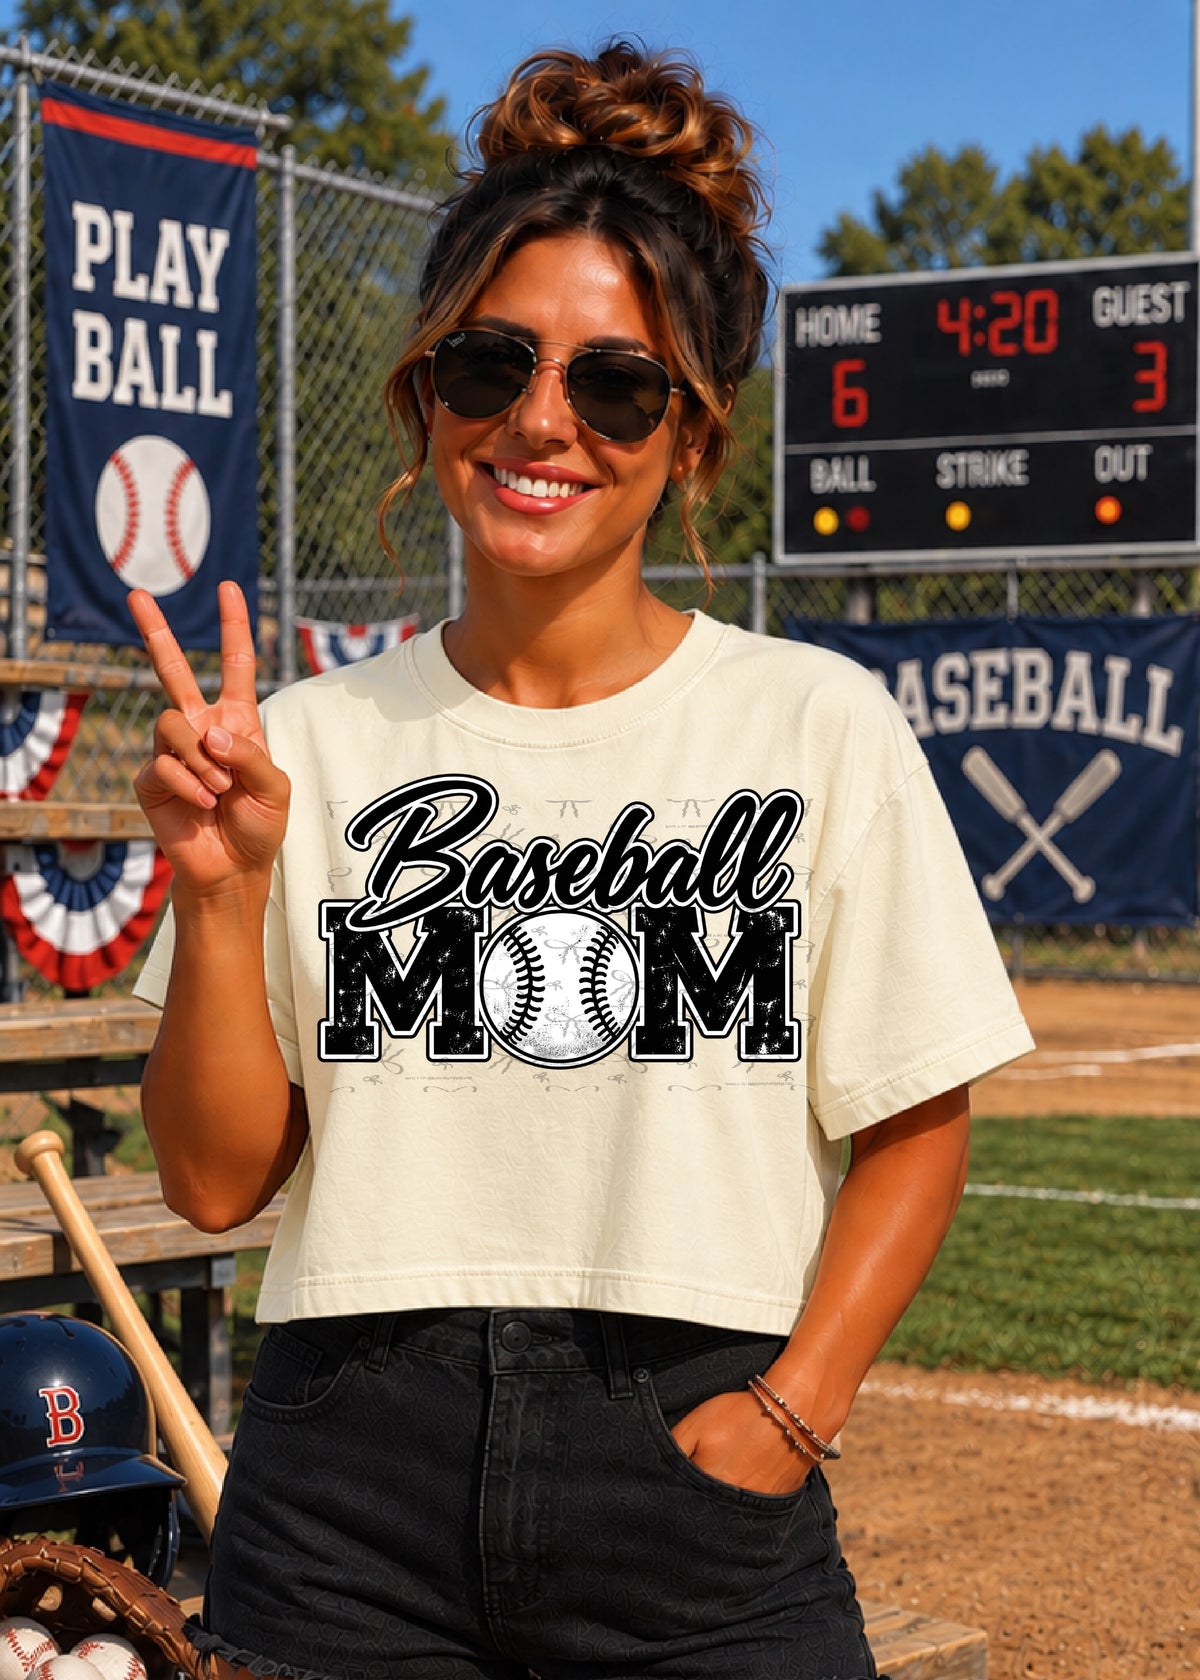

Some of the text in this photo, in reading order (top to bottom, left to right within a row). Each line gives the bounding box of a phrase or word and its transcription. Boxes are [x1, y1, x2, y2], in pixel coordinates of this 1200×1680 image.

[72, 200, 231, 314] PLAY
[796, 303, 882, 348] HOME
[937, 288, 1058, 357] 4:20
[1092, 281, 1191, 328] GUEST
[72, 308, 233, 419] BALL
[832, 358, 869, 429] 6
[1132, 341, 1168, 413] 3
[809, 456, 877, 495] BALL
[936, 449, 1029, 489] STRIKE
[1094, 444, 1153, 484] OUT
[869, 647, 1184, 757] ASEBALL
[345, 774, 804, 932] Baseball
[318, 900, 802, 1070] MOM
[39, 1385, 85, 1448] B
